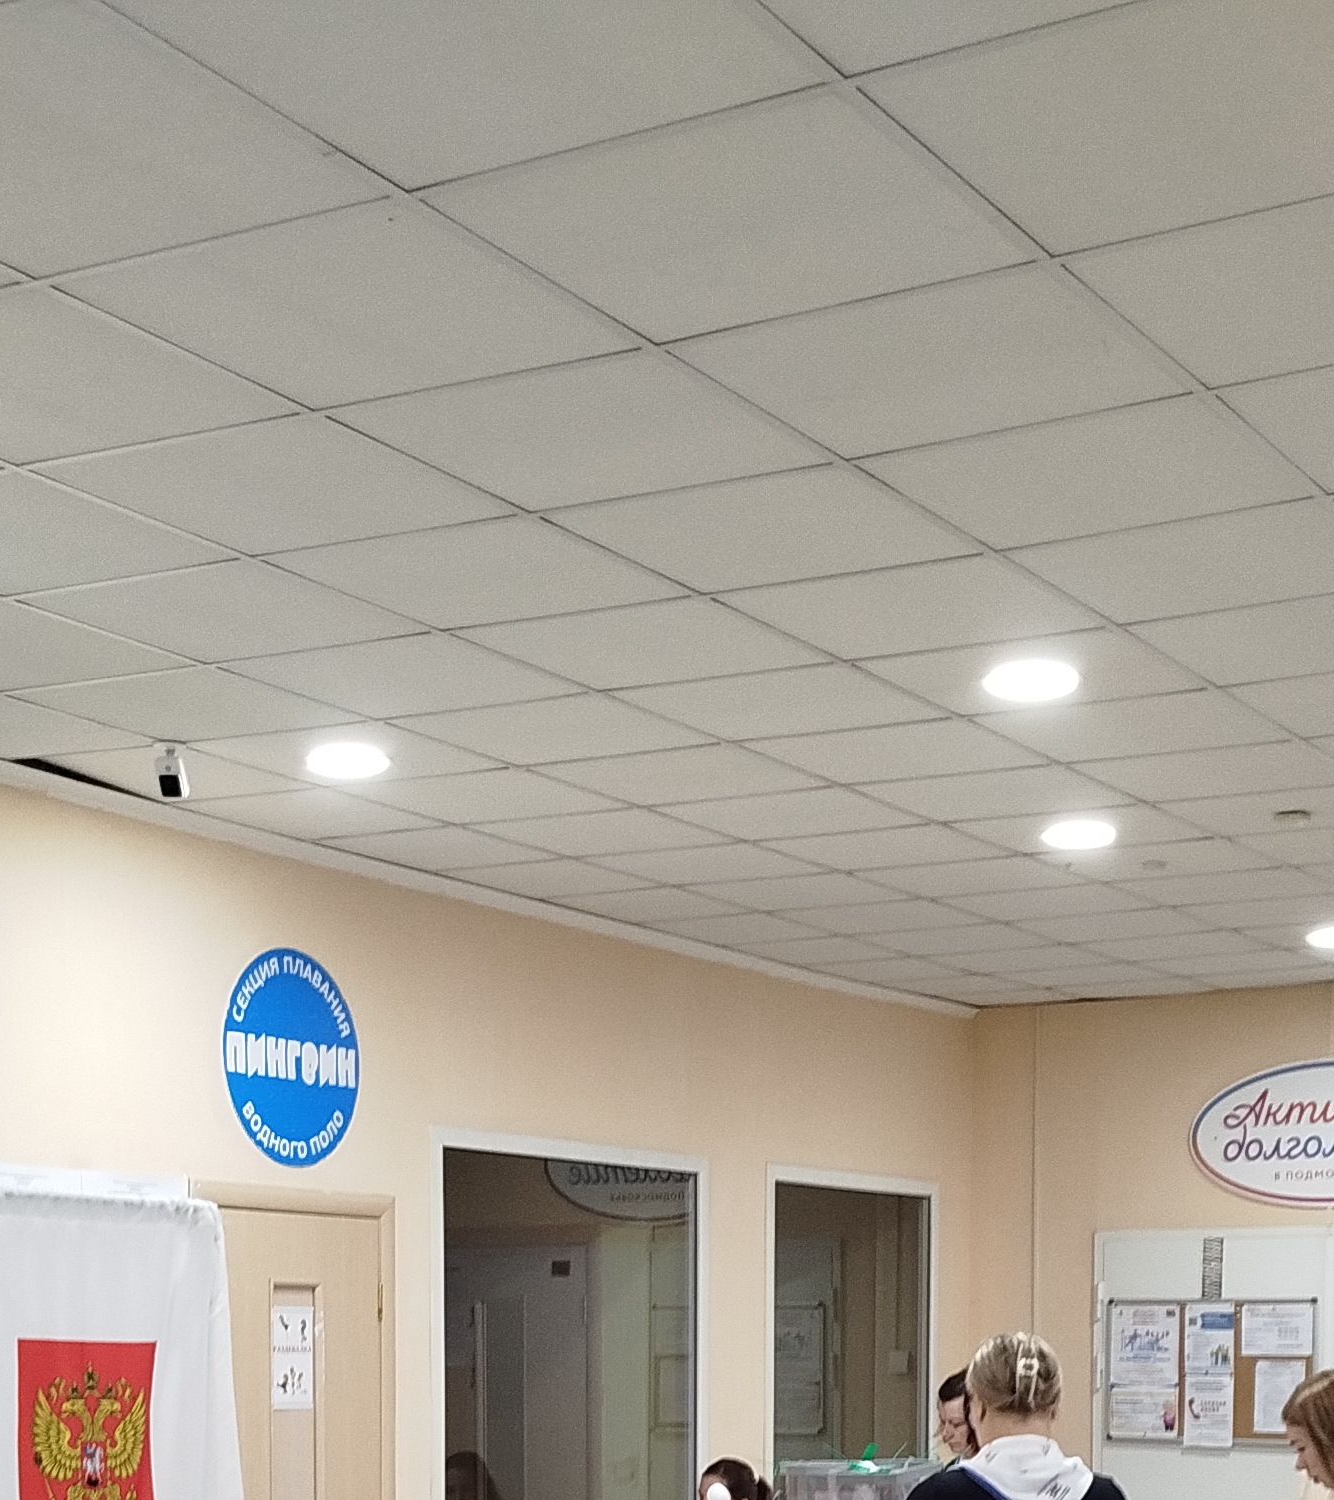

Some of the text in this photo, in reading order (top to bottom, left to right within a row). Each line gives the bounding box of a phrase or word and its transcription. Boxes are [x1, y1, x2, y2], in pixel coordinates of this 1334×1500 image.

[232, 955, 351, 1038] СЕКЦИЯ ПЛАВАНИЯ
[242, 1100, 344, 1159] ВОДНОГО ПОЛО
